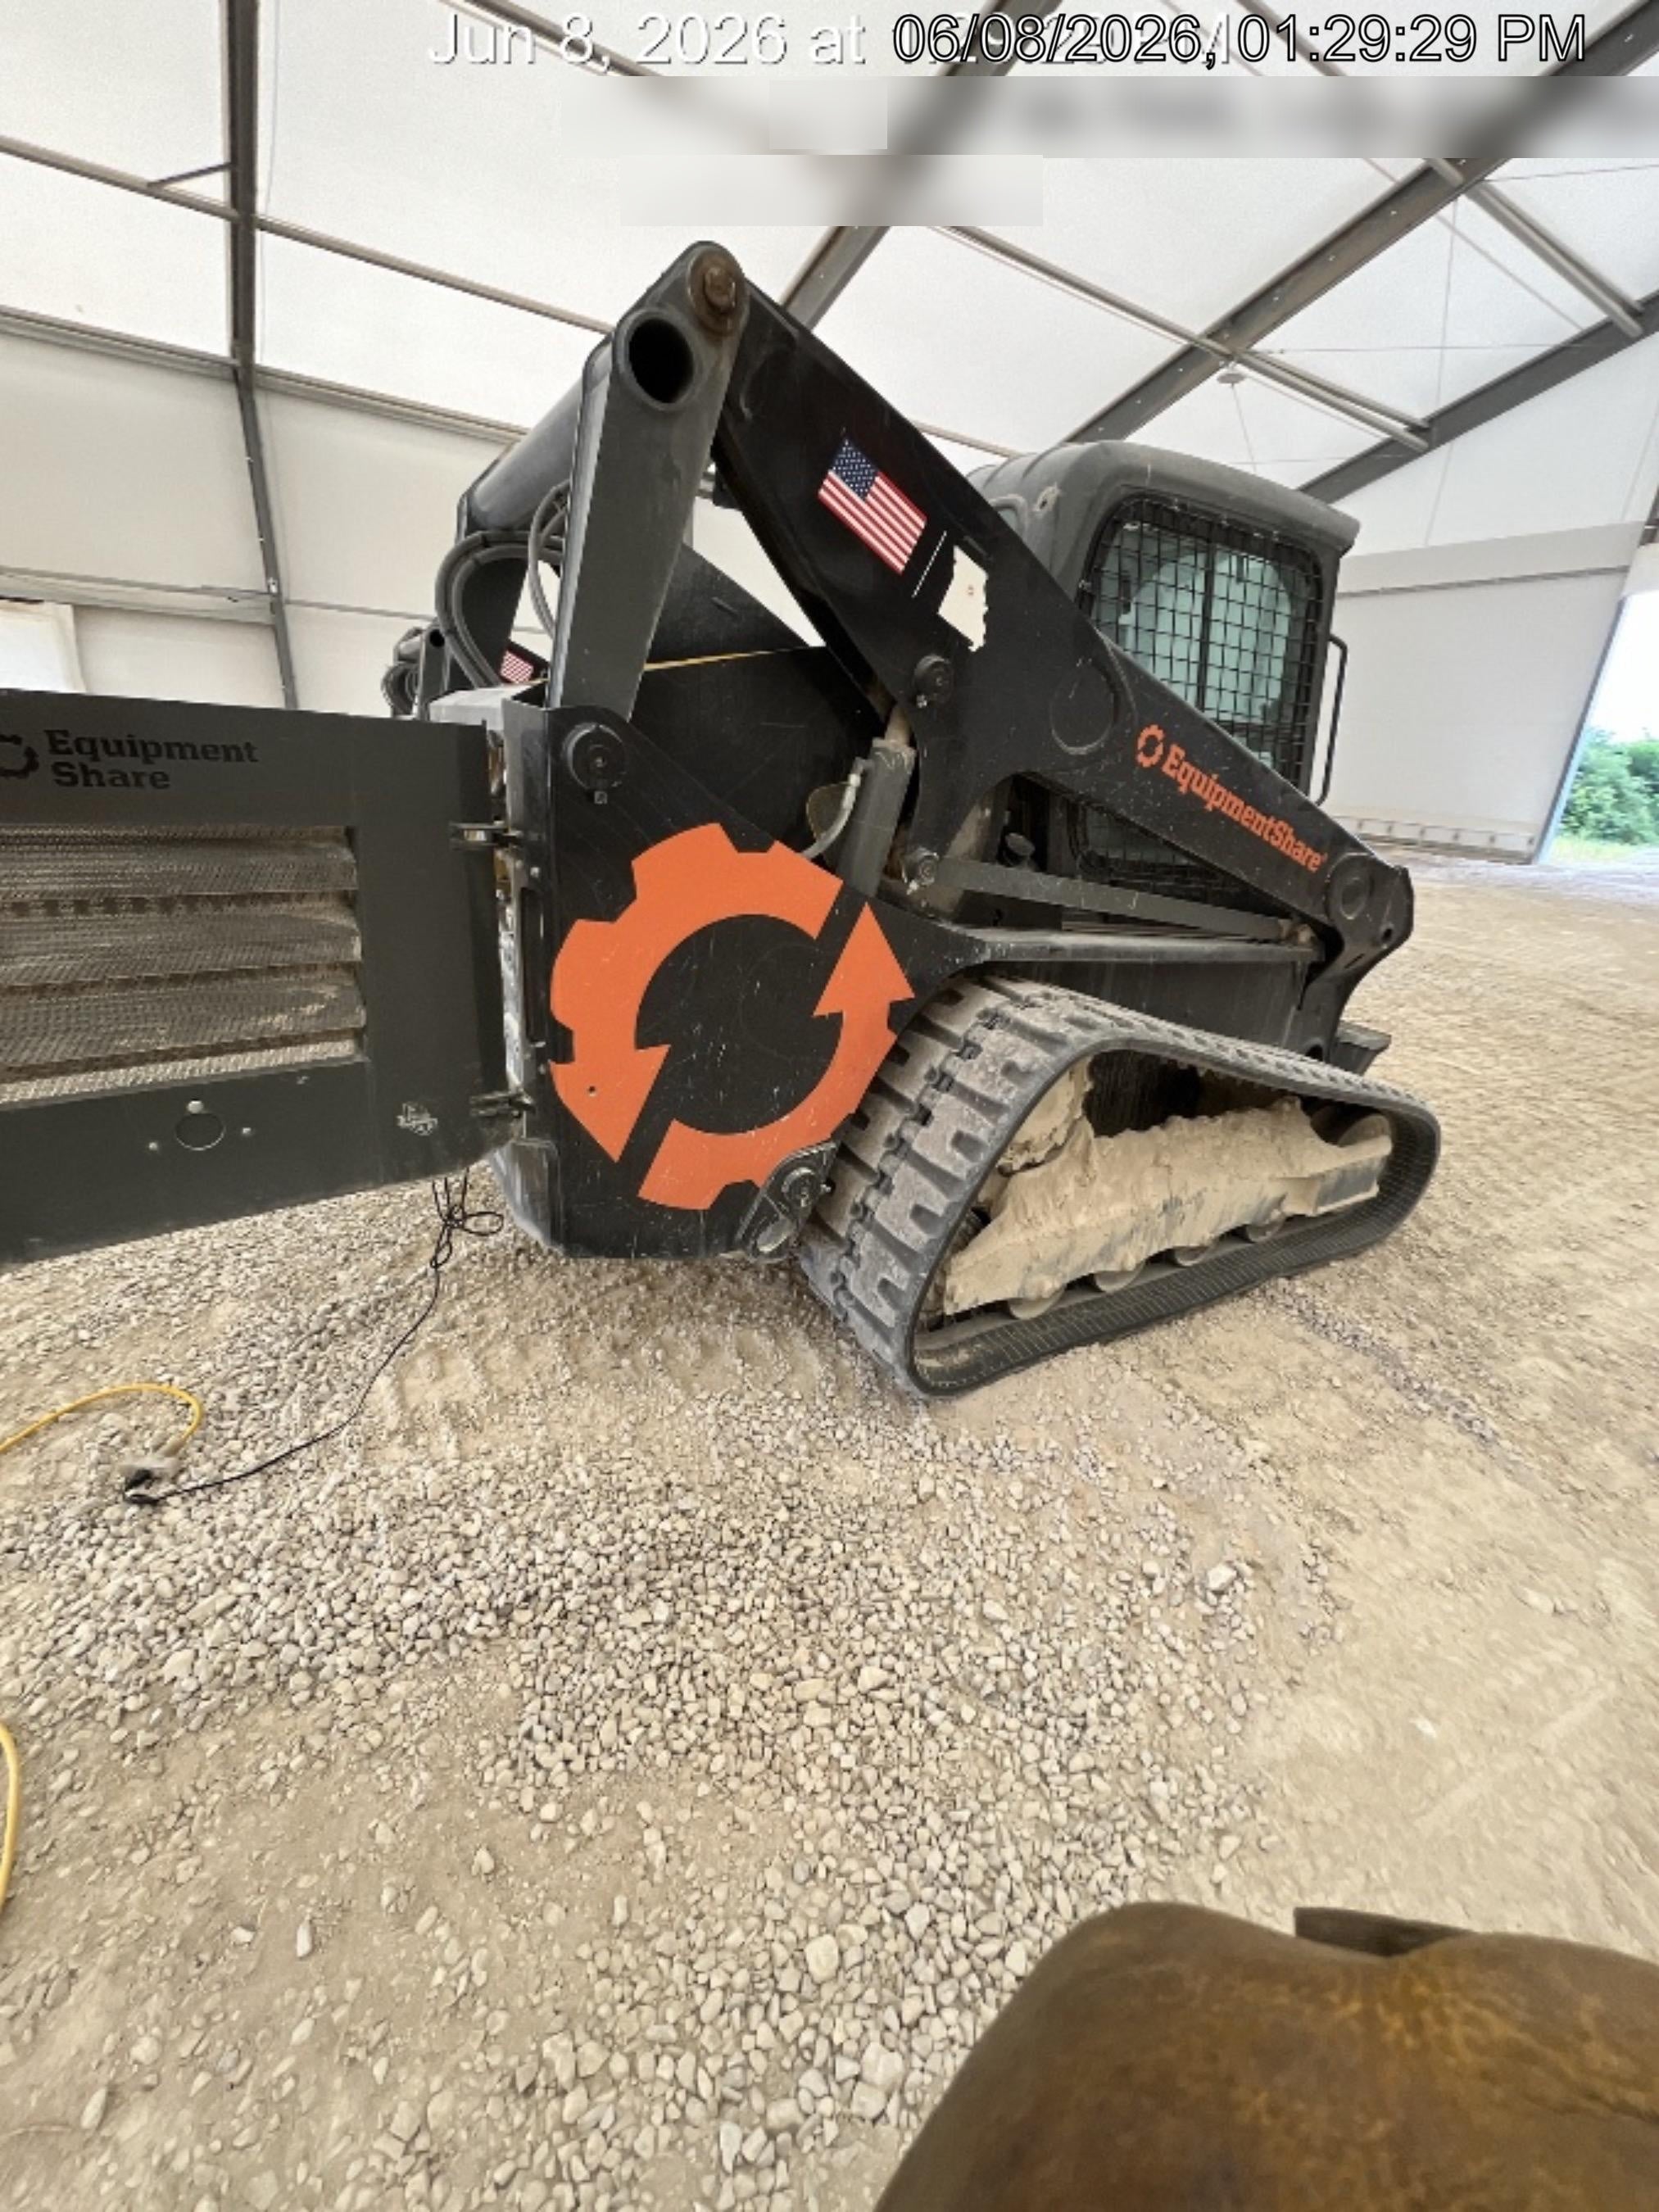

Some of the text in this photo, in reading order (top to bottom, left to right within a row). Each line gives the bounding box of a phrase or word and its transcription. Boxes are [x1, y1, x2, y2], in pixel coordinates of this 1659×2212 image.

[43, 729, 260, 765] Equipment
[50, 761, 171, 790] Share
[1161, 743, 1322, 874] EquipmentShare
